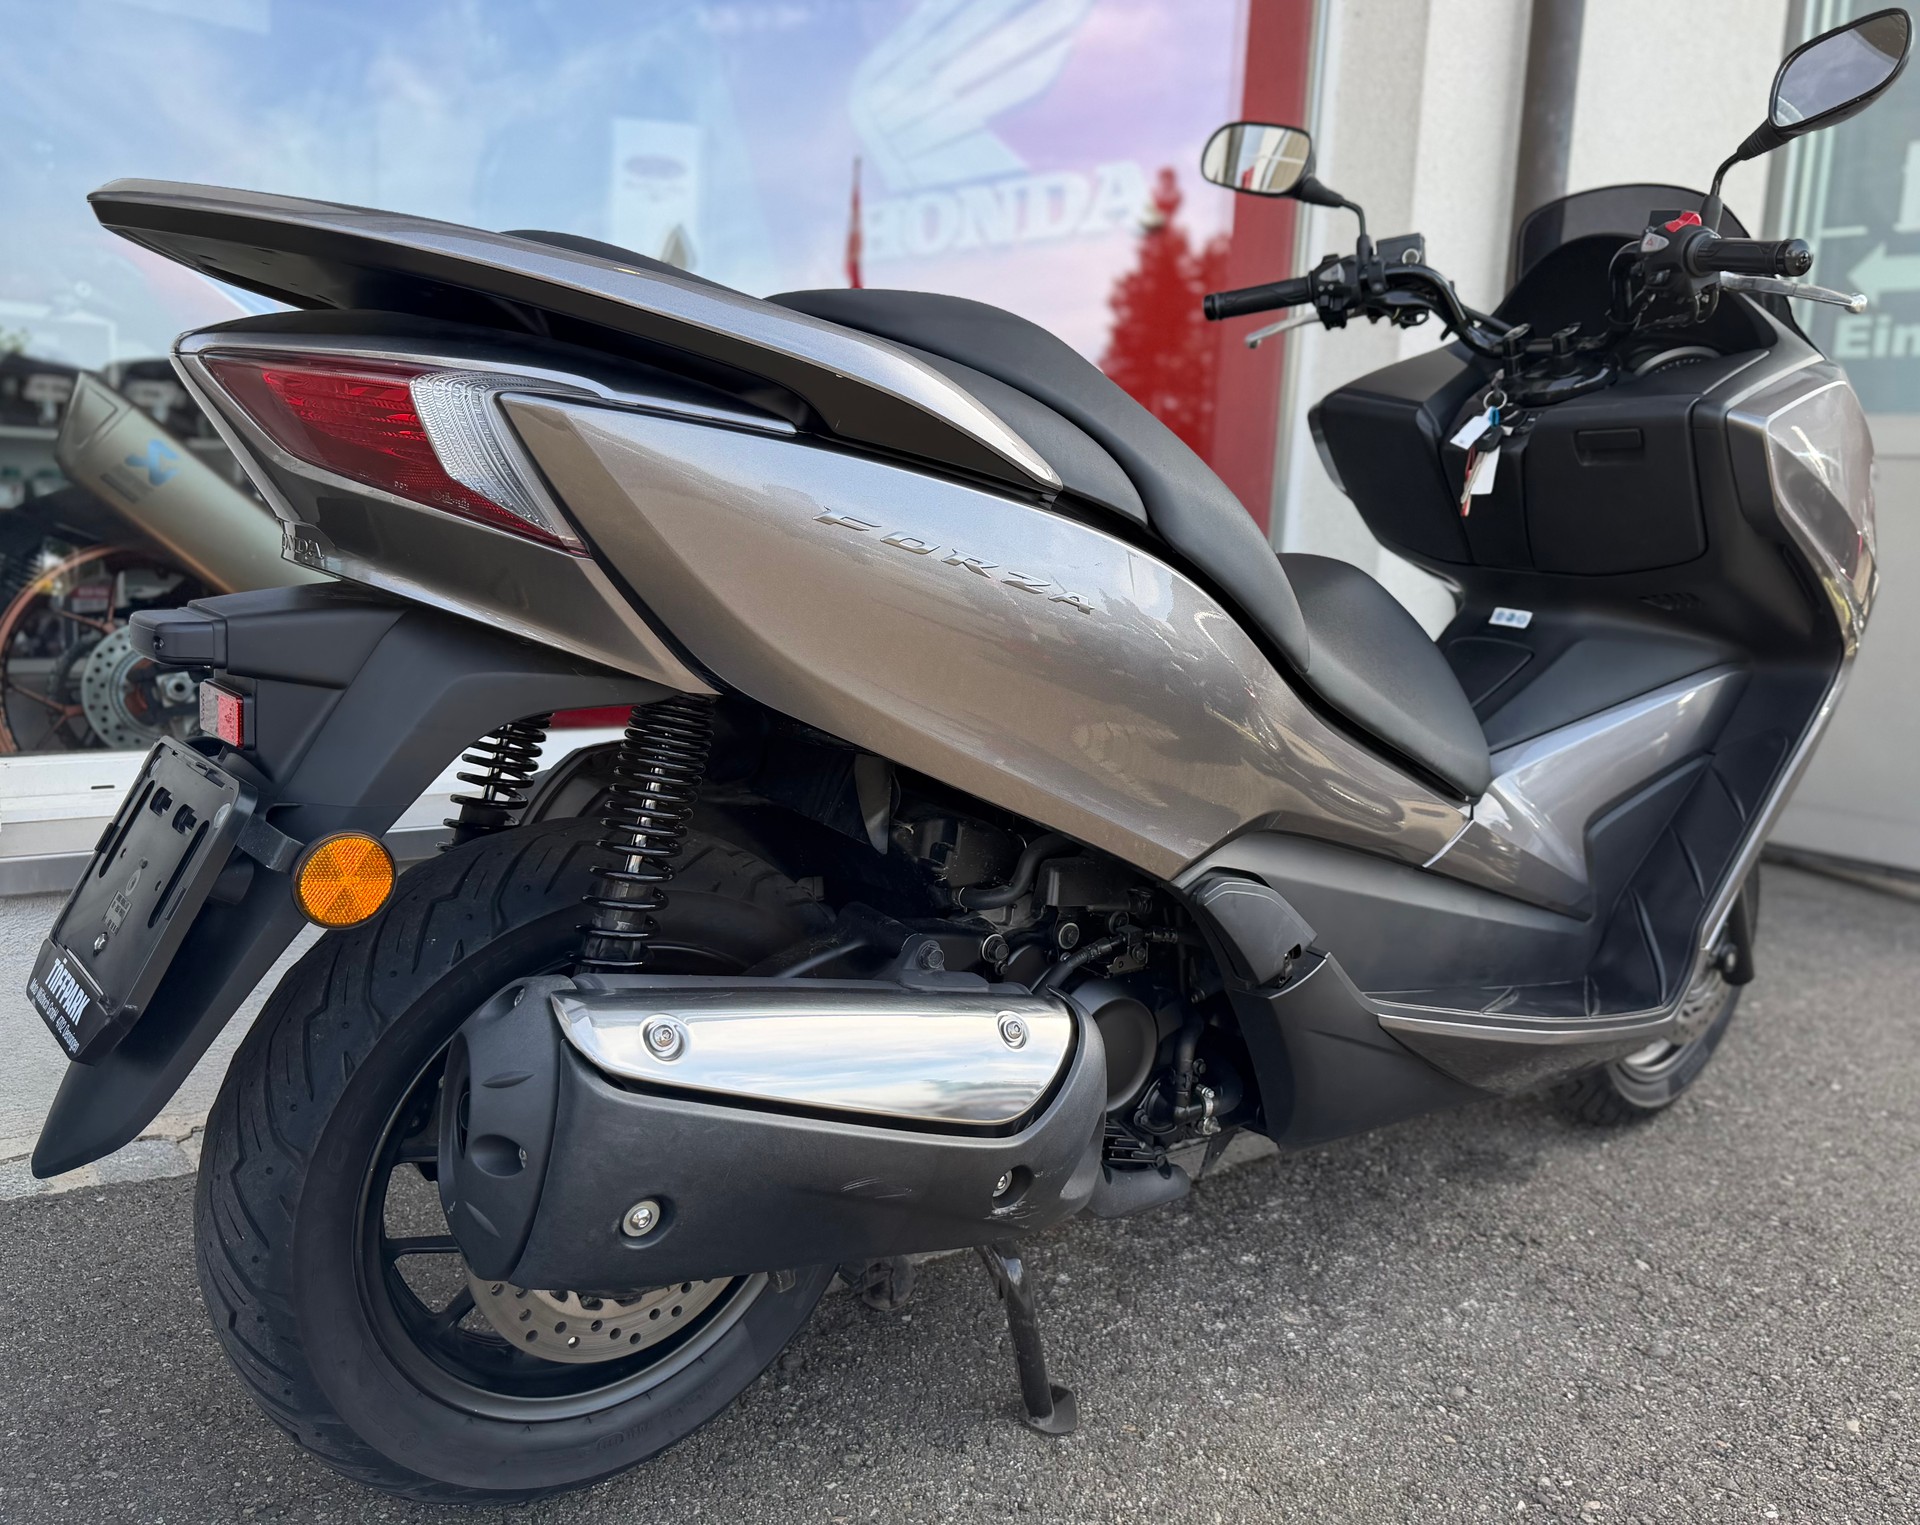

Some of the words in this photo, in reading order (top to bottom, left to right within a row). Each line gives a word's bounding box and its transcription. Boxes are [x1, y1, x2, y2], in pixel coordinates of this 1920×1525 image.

[864, 159, 1157, 262] HONDA
[812, 505, 1096, 615] FORZA
[45, 957, 91, 1026] TÖFFPARK
